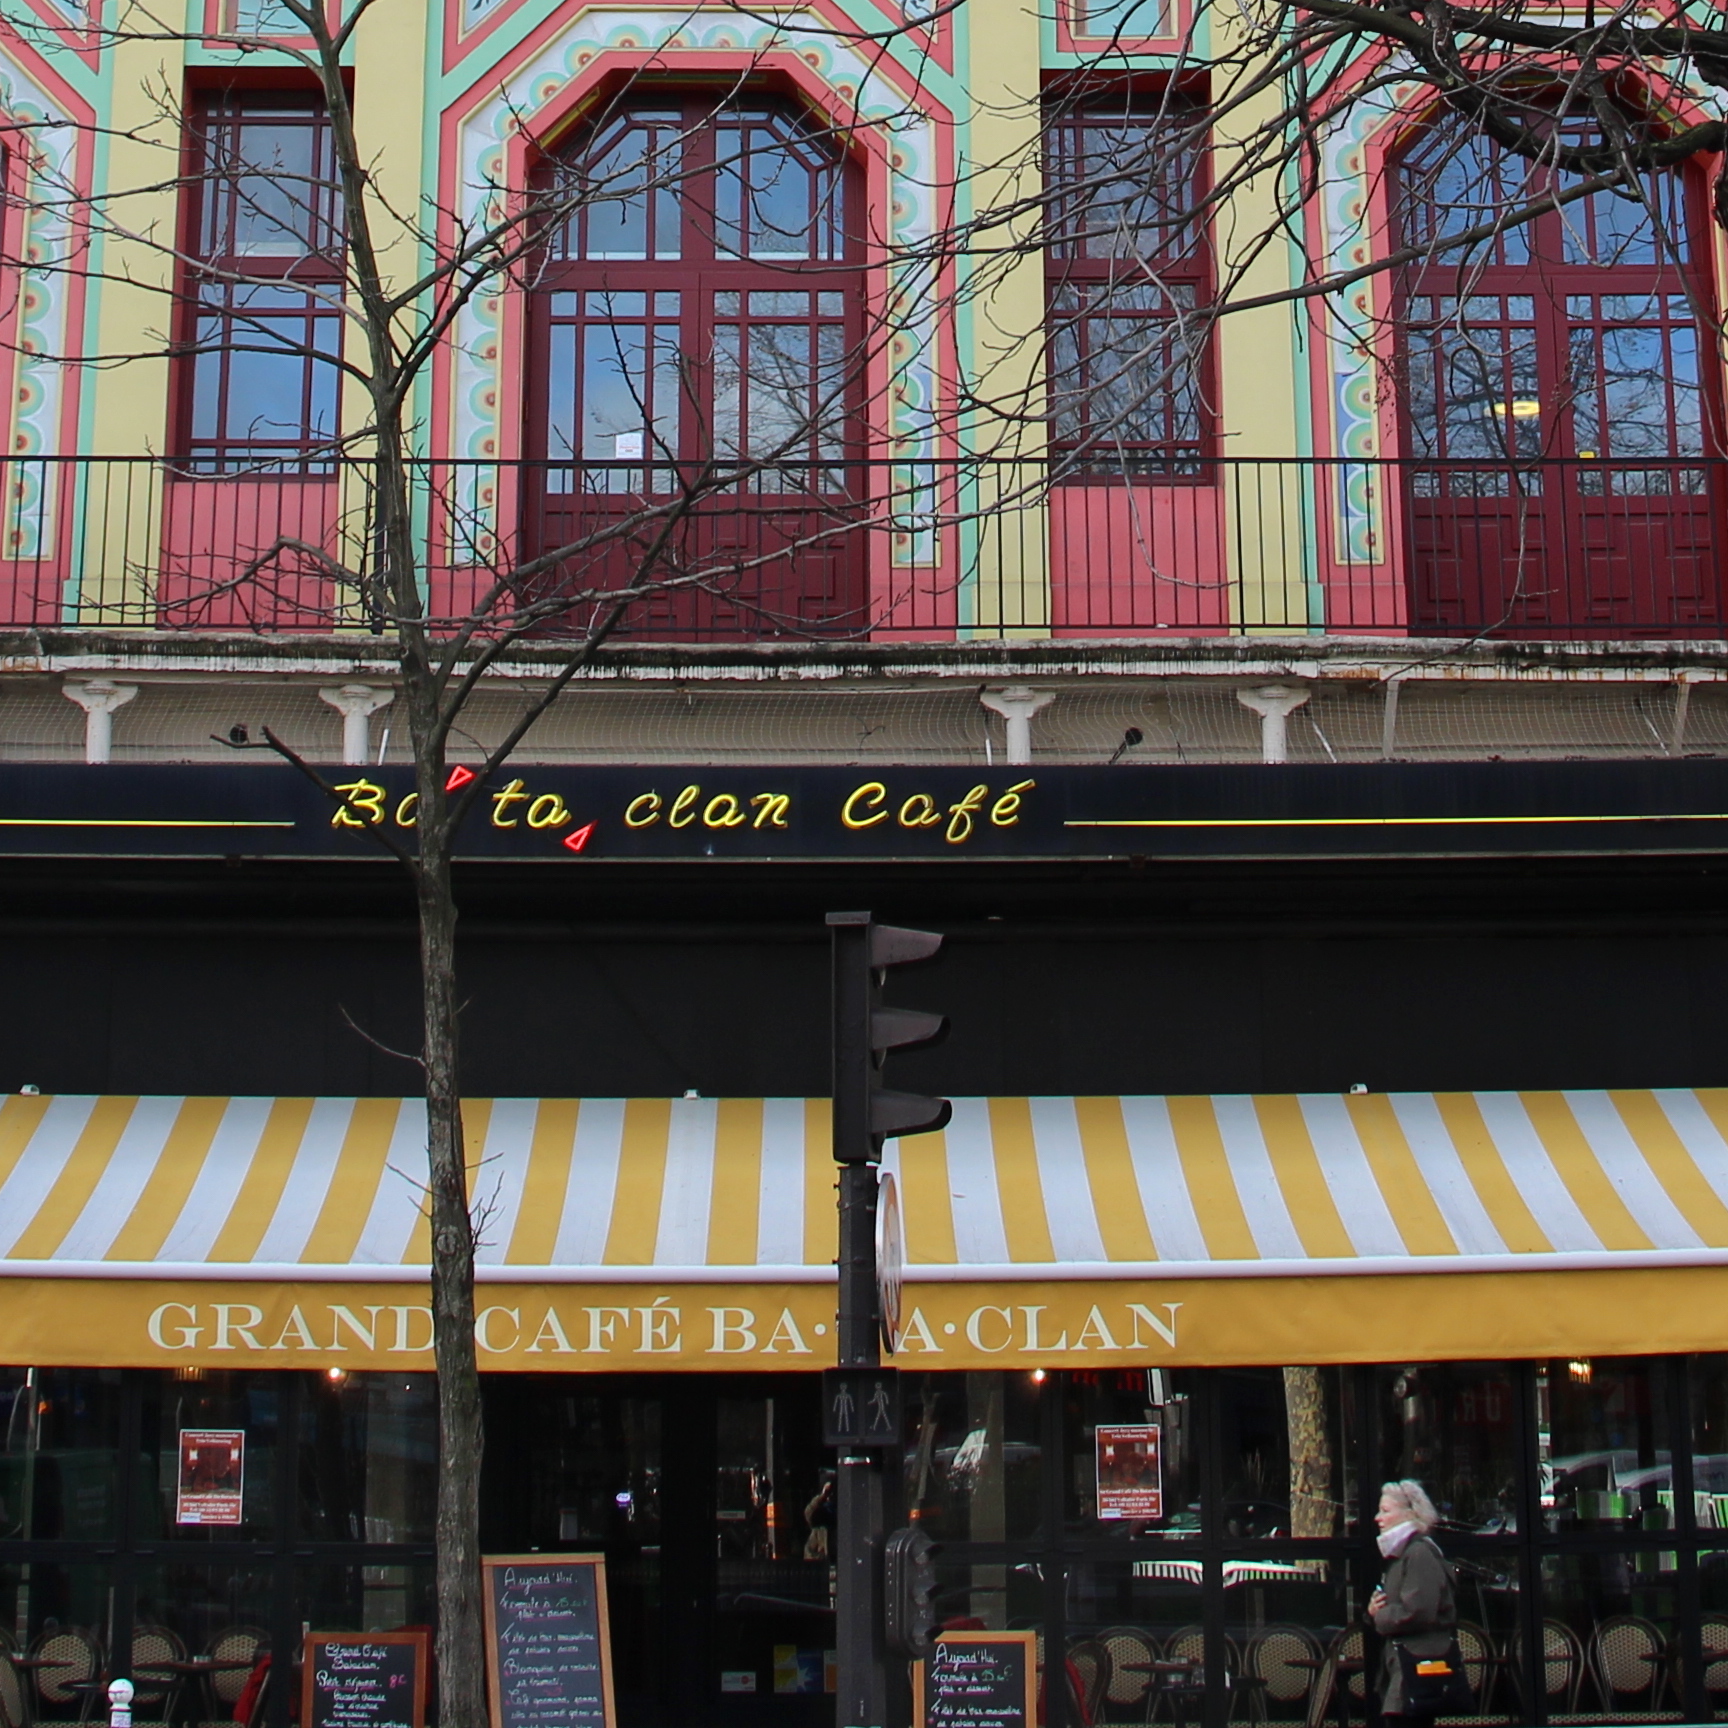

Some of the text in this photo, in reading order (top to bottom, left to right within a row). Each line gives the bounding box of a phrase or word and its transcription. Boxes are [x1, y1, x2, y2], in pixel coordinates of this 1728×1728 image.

[623, 784, 789, 829] clan
[840, 778, 1035, 844] Café
[146, 1302, 435, 1353] GRAND
[474, 1296, 682, 1354] CAFÉ
